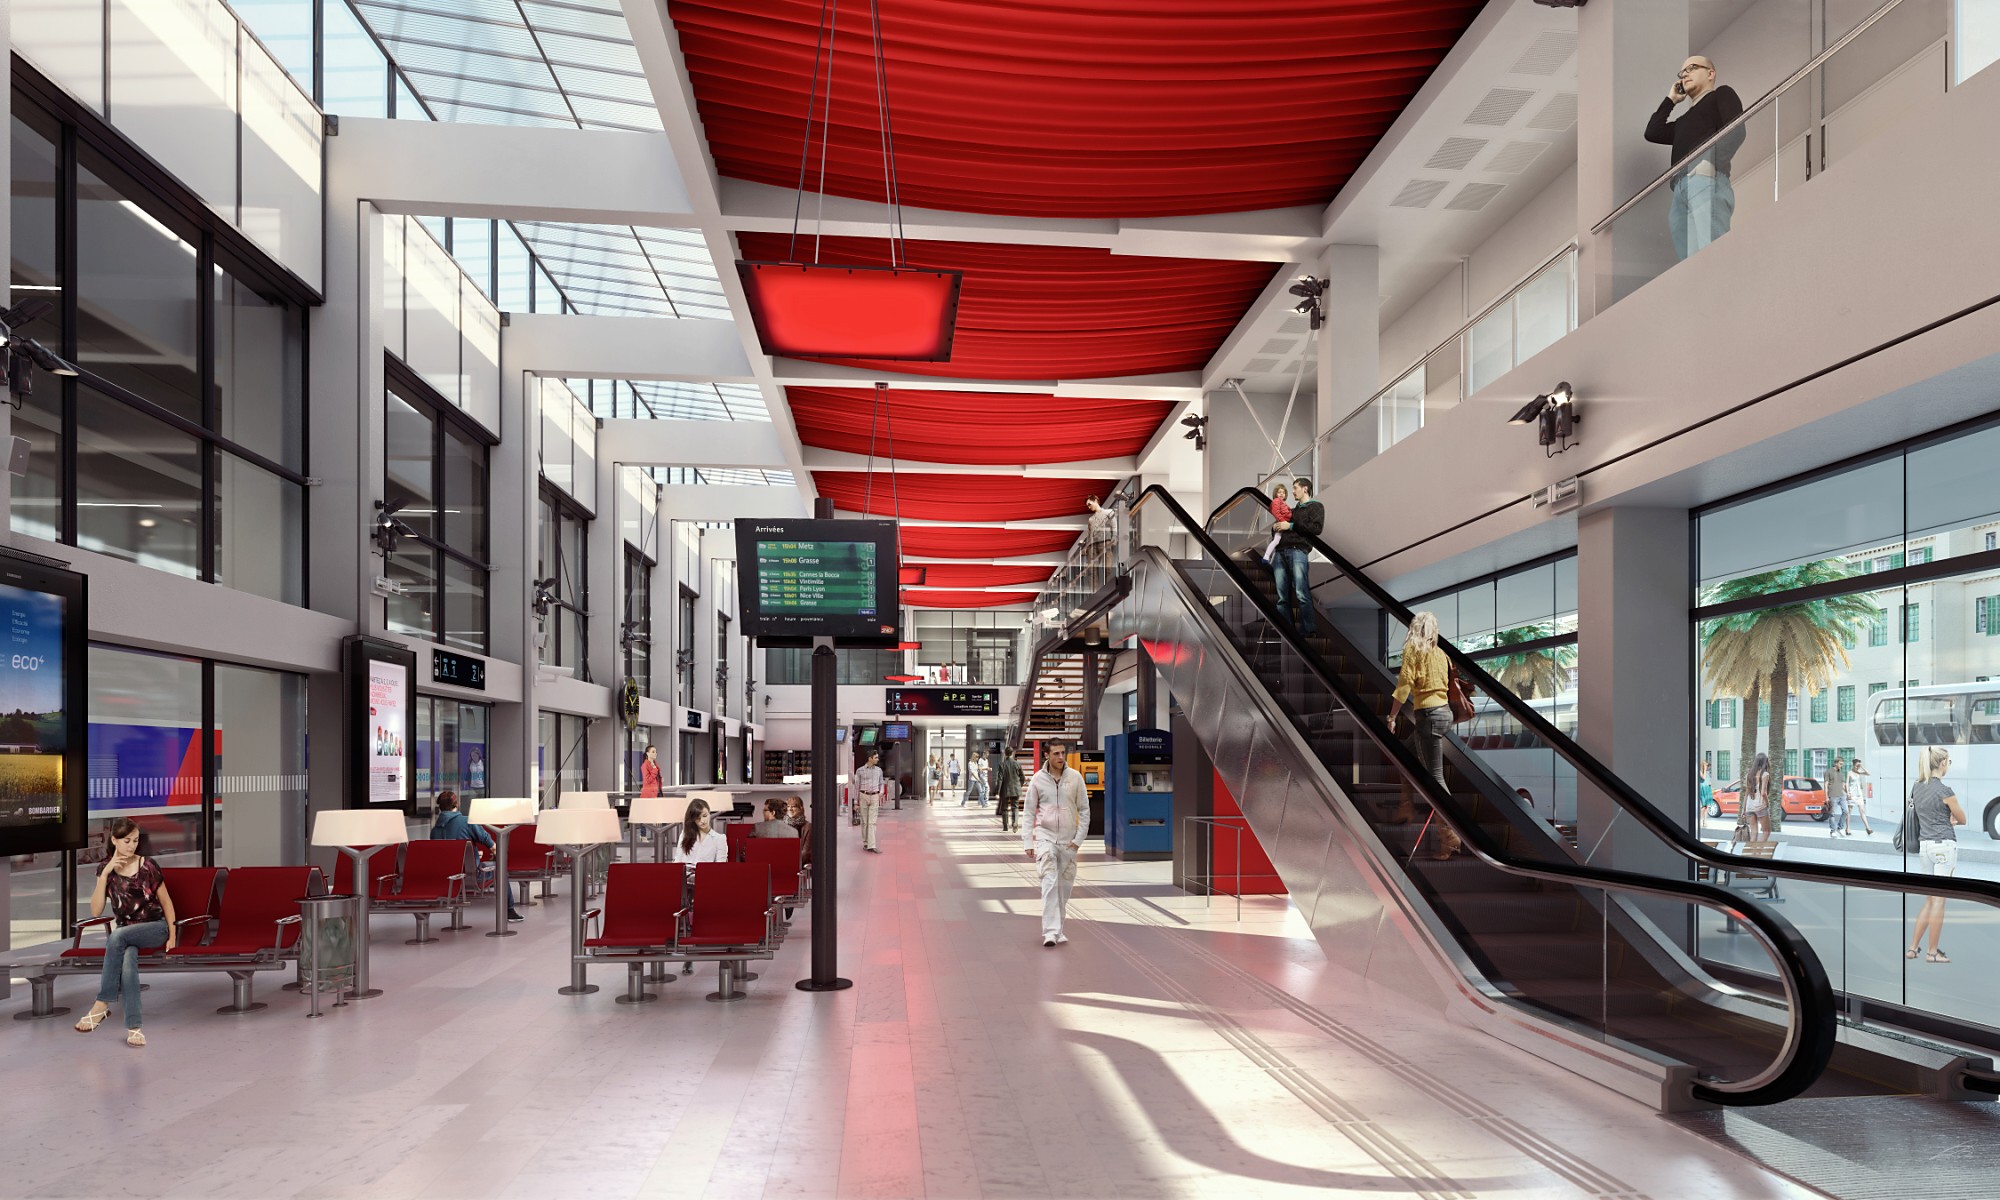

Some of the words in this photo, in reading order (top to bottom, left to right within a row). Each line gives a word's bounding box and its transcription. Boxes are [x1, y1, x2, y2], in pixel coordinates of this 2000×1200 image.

[755, 525, 784, 533] Arrivées
[798, 542, 814, 550] Metz
[798, 556, 820, 565] Grasse
[812, 585, 826, 593] Lyon
[28, 806, 60, 815] BOMBARDIER
